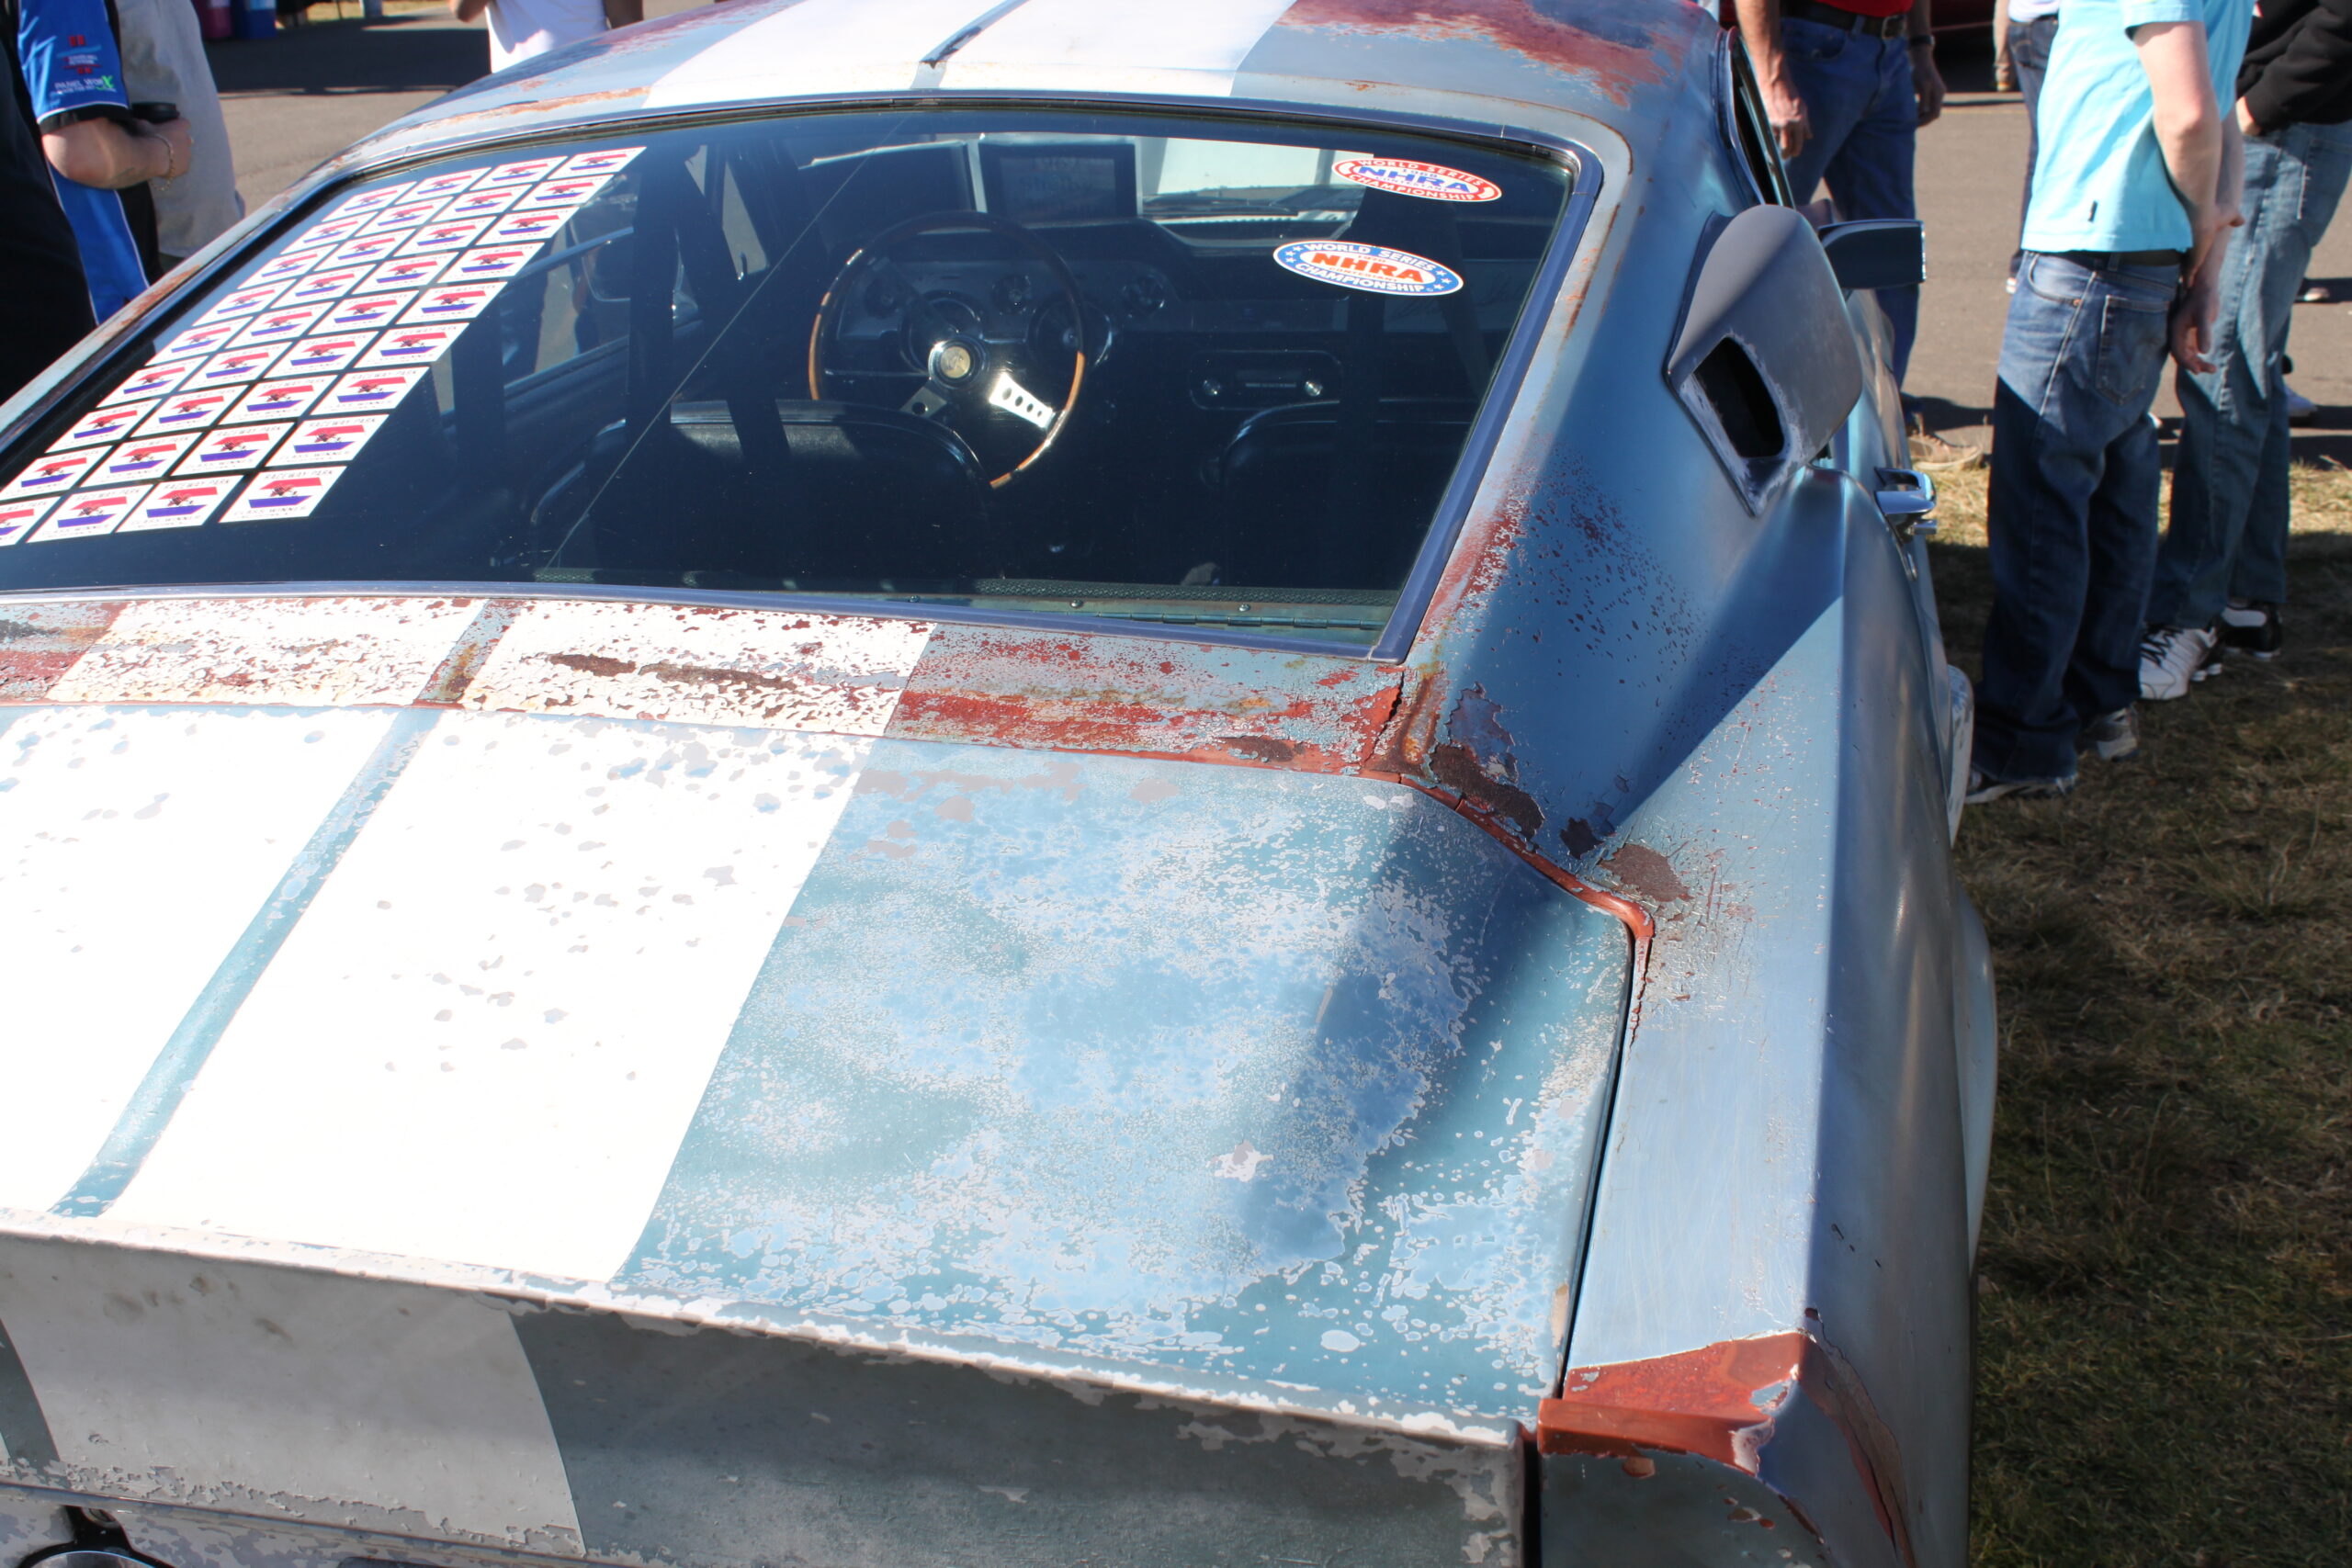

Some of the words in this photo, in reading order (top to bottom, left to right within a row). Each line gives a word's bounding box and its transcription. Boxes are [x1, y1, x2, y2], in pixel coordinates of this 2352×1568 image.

[1359, 159, 1419, 169] WORLD
[1427, 166, 1484, 186] SERIES
[1359, 166, 1470, 192] NHRA
[1350, 174, 1476, 200] CHAMPIONSHIP
[1304, 243, 1371, 254] WORLD
[1377, 250, 1437, 271] SERIES
[1311, 253, 1424, 283] NHRA
[1295, 263, 1424, 292] CHAMPIONSHIP
